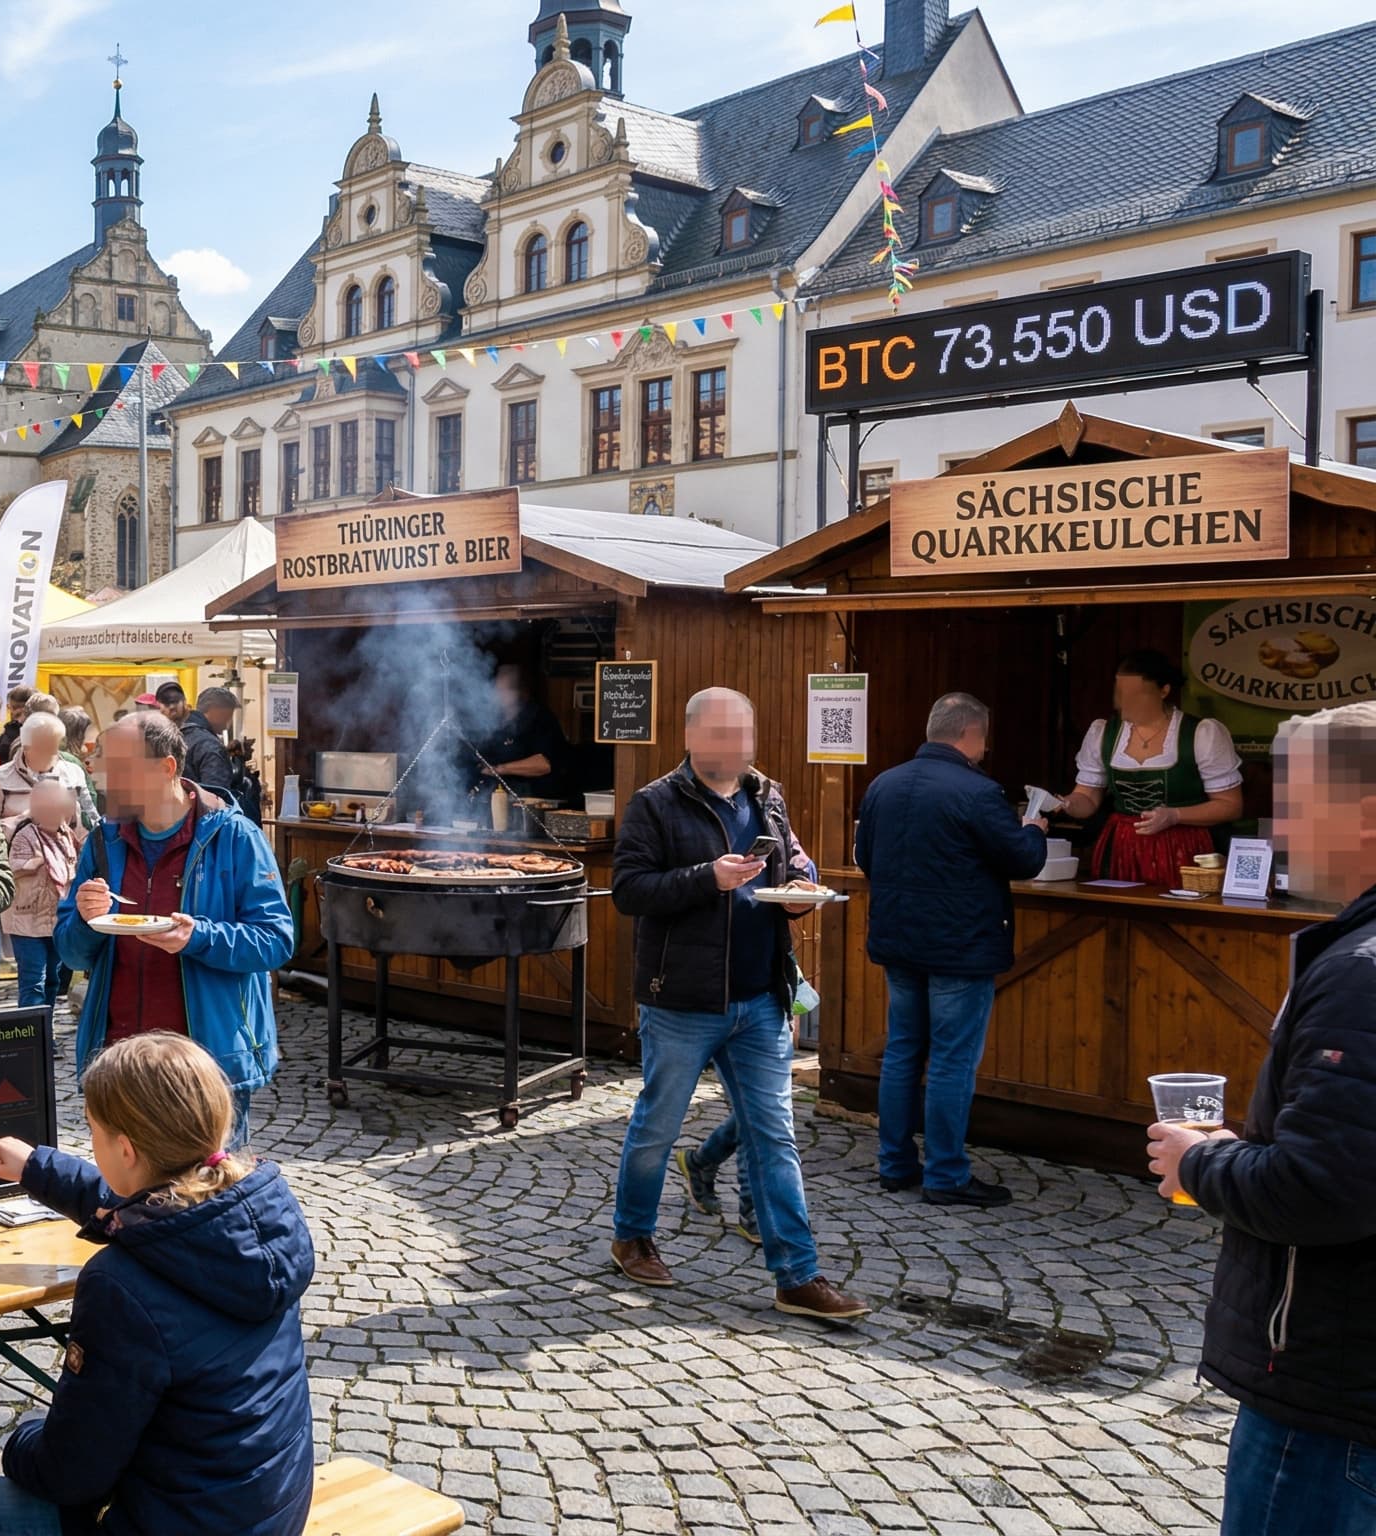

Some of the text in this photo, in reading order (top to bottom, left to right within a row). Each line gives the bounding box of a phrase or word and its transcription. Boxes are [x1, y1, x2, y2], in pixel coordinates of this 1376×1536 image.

[818, 281, 1271, 390] BTC 73.550 USD
[956, 471, 1203, 521] SÄCHSISCHE
[337, 511, 446, 545] THÜRINGER
[911, 509, 1262, 564] QUARKKEULCHEN
[283, 536, 511, 579] ROSTBRATWURST & BIER
[1208, 601, 1376, 647] SÄCHSISCH
